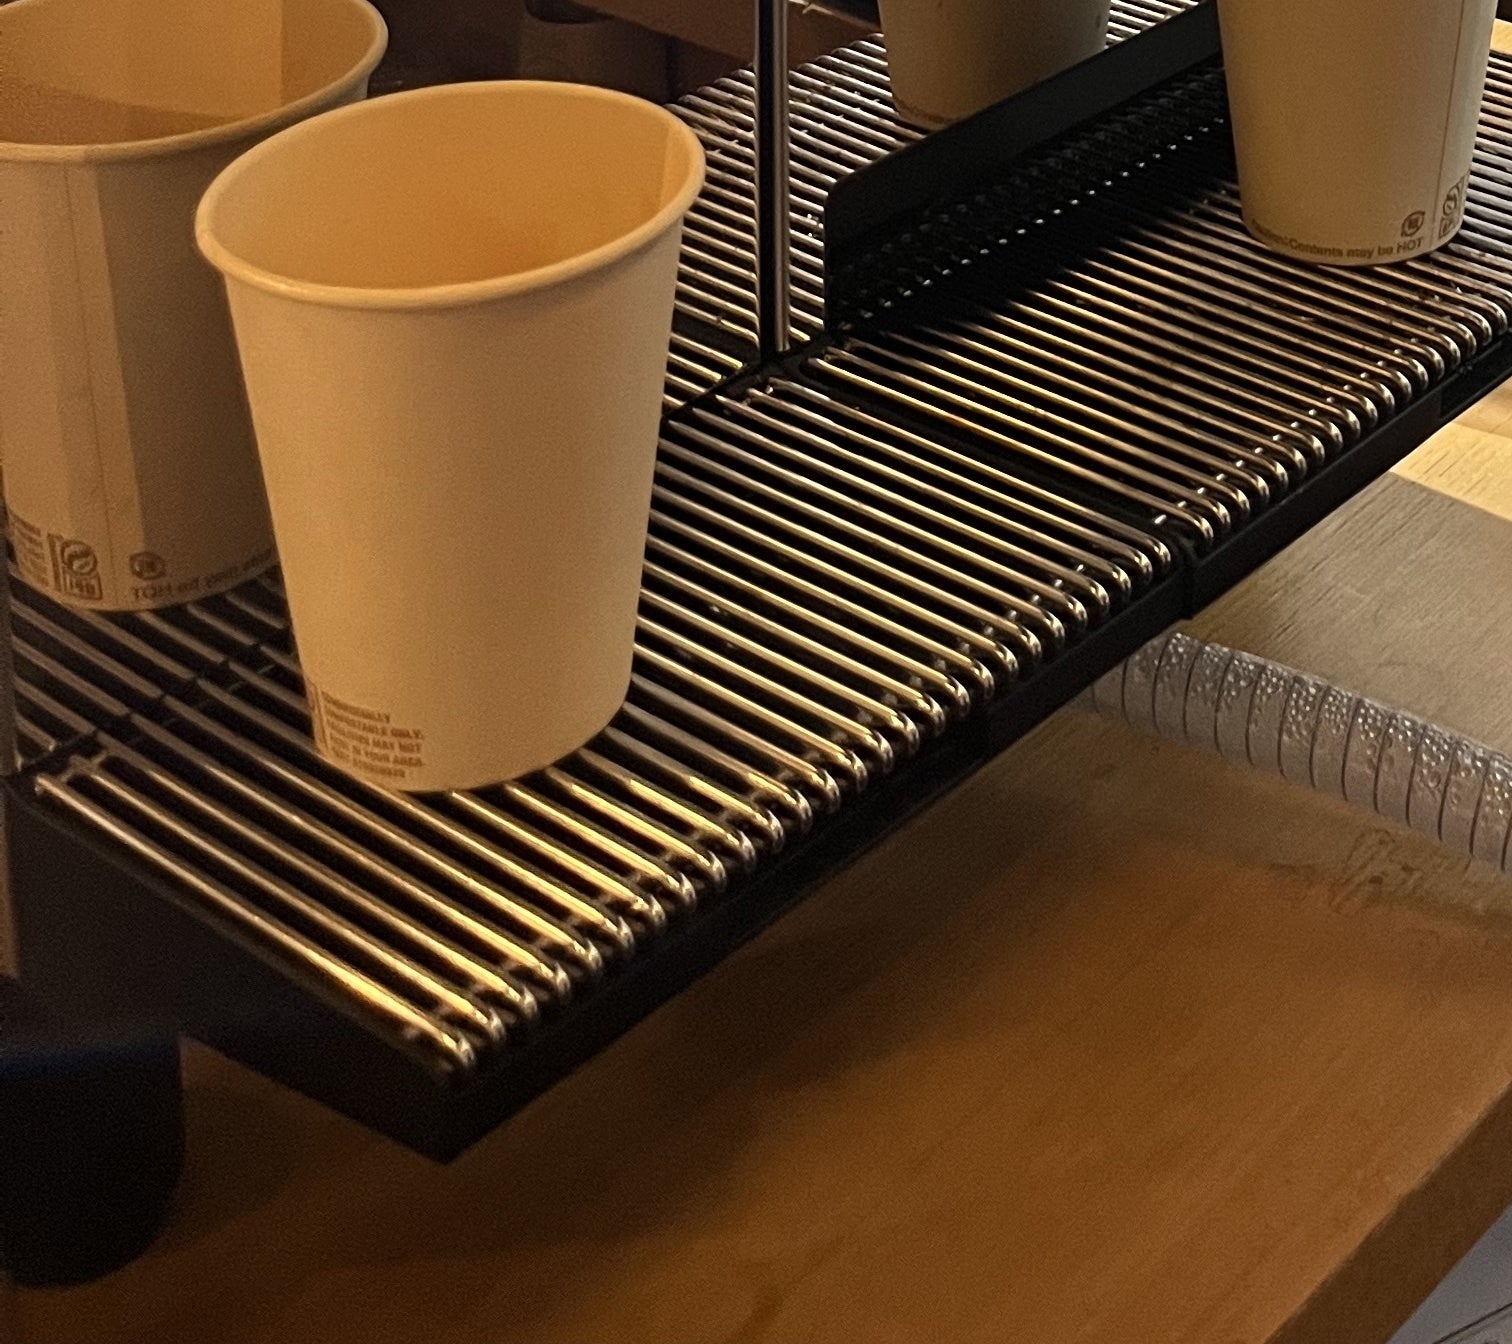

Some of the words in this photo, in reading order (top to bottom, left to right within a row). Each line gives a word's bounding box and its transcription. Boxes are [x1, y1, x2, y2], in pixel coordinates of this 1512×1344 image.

[1346, 246, 1374, 260] may
[1377, 244, 1394, 256] be
[1396, 238, 1423, 254] HOT
